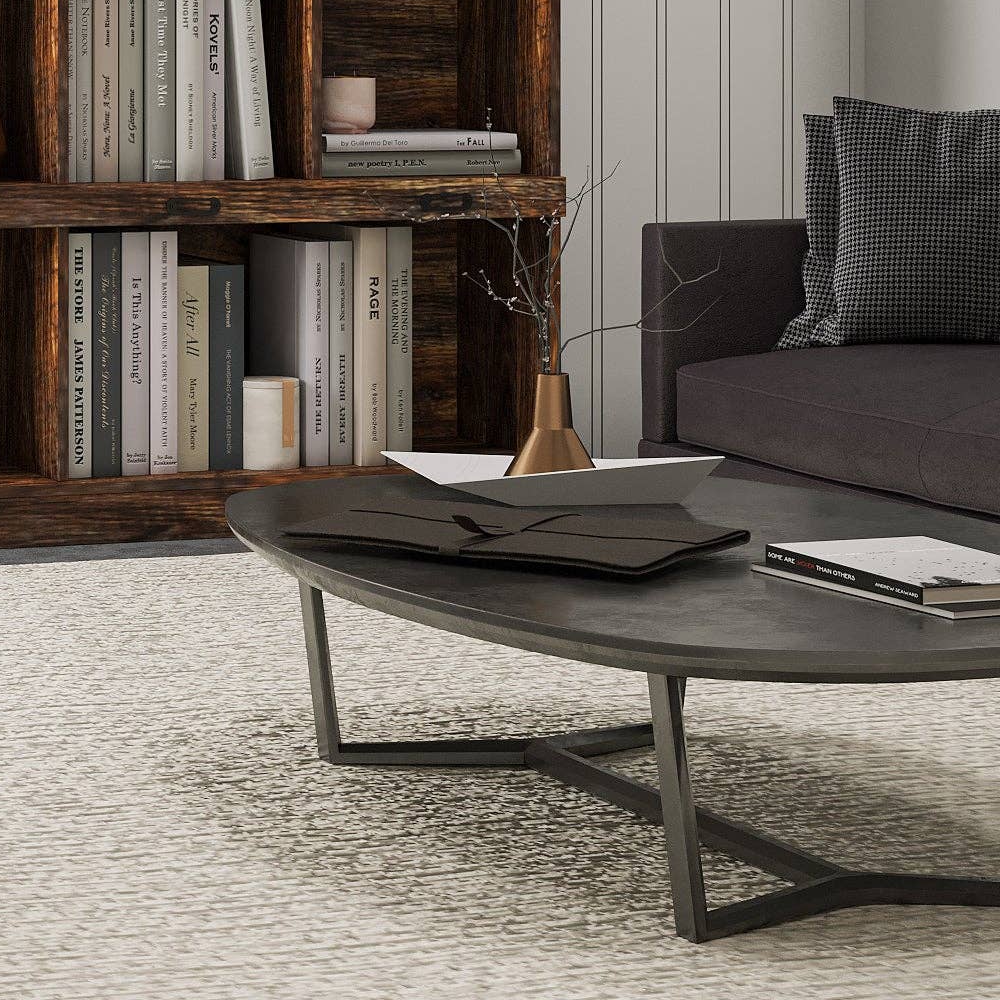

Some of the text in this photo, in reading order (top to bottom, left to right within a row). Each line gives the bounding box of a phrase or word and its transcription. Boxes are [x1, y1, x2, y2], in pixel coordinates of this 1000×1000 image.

[245, 0, 253, 22] Noon
[158, 17, 167, 46] Time
[193, 26, 199, 39] OF
[246, 25, 256, 54] Night:
[156, 51, 167, 80] They
[249, 66, 259, 84] Way
[158, 85, 167, 107] Met
[252, 88, 261, 96] of
[253, 99, 262, 127] Living
[467, 137, 484, 145] FALL
[370, 277, 379, 320] RAGE
[130, 278, 141, 384] Is This Anything?
[182, 291, 199, 357] After All
[75, 247, 84, 465] THE STORE JAMES PATTERSON
[99, 274, 109, 428] The Origins of Our Discontents
[189, 378, 197, 399] Mary
[189, 402, 197, 422] Tyler
[784, 556, 795, 564] ARE
[816, 564, 832, 575] THAN
[833, 569, 856, 581] OTHERS
[875, 582, 894, 590] ANDREW
